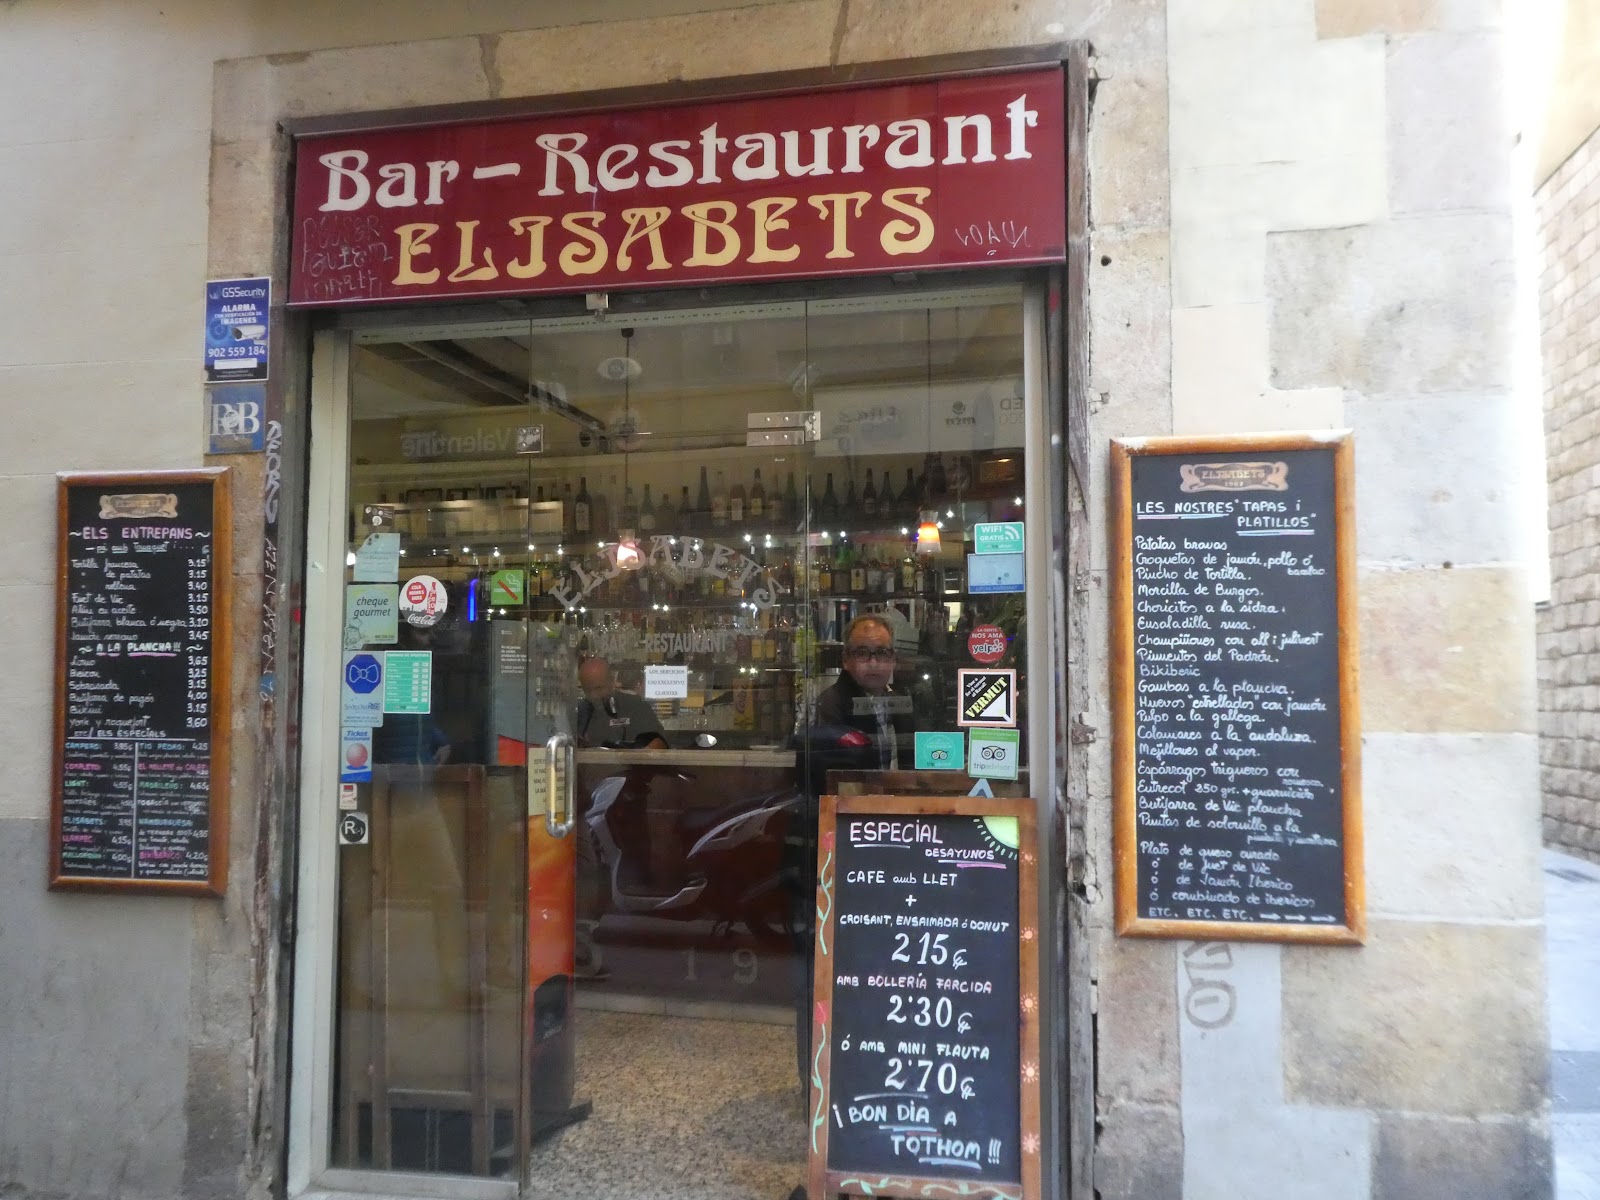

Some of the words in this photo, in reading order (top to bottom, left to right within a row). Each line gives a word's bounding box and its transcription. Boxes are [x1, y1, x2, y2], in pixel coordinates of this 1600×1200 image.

[221, 303, 257, 313] ALARMA
[208, 347, 226, 358] 902
[227, 346, 246, 357] 559
[248, 345, 266, 356] 184
[1136, 501, 1166, 514] LES
[1174, 501, 1235, 514] NOSTRES
[83, 527, 108, 539] ELS
[122, 525, 193, 540] ENTREPANS
[981, 525, 1002, 533] WIFI
[1135, 535, 1177, 551] Patatas
[1184, 537, 1228, 550] bravas
[188, 558, 206, 567] 3.15
[1135, 551, 1195, 571] Croquetas
[1202, 552, 1218, 565] de
[188, 569, 207, 579] 3.15
[1135, 566, 1179, 580] Pincho
[1183, 567, 1199, 580] de
[188, 581, 208, 591] 3.40
[1137, 581, 1190, 597] Morcilla
[1193, 582, 1210, 596] de
[1214, 582, 1264, 603] Burgos.
[188, 593, 209, 603] 3.15
[356, 596, 389, 608] cheque
[189, 604, 208, 615] 3.50
[353, 608, 391, 620] gourmet
[1137, 599, 1198, 614] Choricitos
[1204, 604, 1216, 613] a
[1220, 599, 1236, 613] la
[189, 617, 209, 627] 3.10
[1137, 614, 1213, 630] Ensaladilla
[188, 630, 210, 640] 3.45
[1224, 636, 1246, 646] con
[1250, 631, 1271, 646] all
[1272, 634, 1278, 645] i
[107, 642, 121, 652] LA
[972, 643, 993, 655] yelp
[1203, 647, 1223, 662] del
[187, 679, 207, 689] 3.15
[1137, 678, 1190, 693] Gambas
[1198, 683, 1210, 692] a
[1212, 676, 1229, 692] la
[187, 690, 208, 700] 4.00
[965, 677, 1008, 718] VERMUT
[187, 703, 208, 713] 3.15
[1139, 695, 1186, 709] Huevos
[1261, 701, 1284, 711] con
[1283, 696, 1328, 717] jamón
[1136, 708, 1169, 725] Pulpo
[1175, 713, 1187, 722] a
[1189, 708, 1205, 722] la
[1137, 724, 1203, 741] Calamares
[1210, 731, 1223, 741] a
[1226, 723, 1242, 742] la
[1139, 741, 1199, 761] Mejillones
[1205, 742, 1219, 757] al
[1137, 759, 1207, 783] Espárragos
[1210, 760, 1269, 783] trigueros
[1275, 767, 1300, 778] con
[1137, 778, 1189, 795] Entrecot
[1194, 783, 1219, 793] 250
[1138, 795, 1198, 817] Butifarra
[1204, 798, 1221, 812] de
[1222, 799, 1242, 813] Vic
[1185, 815, 1202, 828] de
[1272, 824, 1284, 833] a
[1285, 817, 1302, 834] la
[924, 846, 996, 861] DESAYUNOS
[1140, 840, 1170, 856] Plato
[1178, 843, 1194, 856] de
[1197, 848, 1233, 865] queso
[1177, 858, 1195, 871] de
[1231, 861, 1248, 873] de
[846, 870, 886, 886] CAFE
[893, 872, 918, 886] amb
[922, 872, 958, 887] LLET
[1175, 874, 1191, 885] de
[1245, 892, 1261, 905] de
[1148, 907, 1179, 918] ETC.
[896, 914, 960, 930] ENSAIMADA
[970, 918, 1010, 933] DONUT
[836, 974, 860, 989] AMB
[867, 972, 928, 990] BOLLERÍA
[936, 976, 993, 994] FARCIDA
[860, 1040, 887, 1055] AMB
[897, 1041, 927, 1056] MINI
[936, 1042, 991, 1062] FLAUTA
[848, 1105, 888, 1124] BON
[943, 1110, 958, 1127] A
[890, 1135, 981, 1162] TOTHOM
